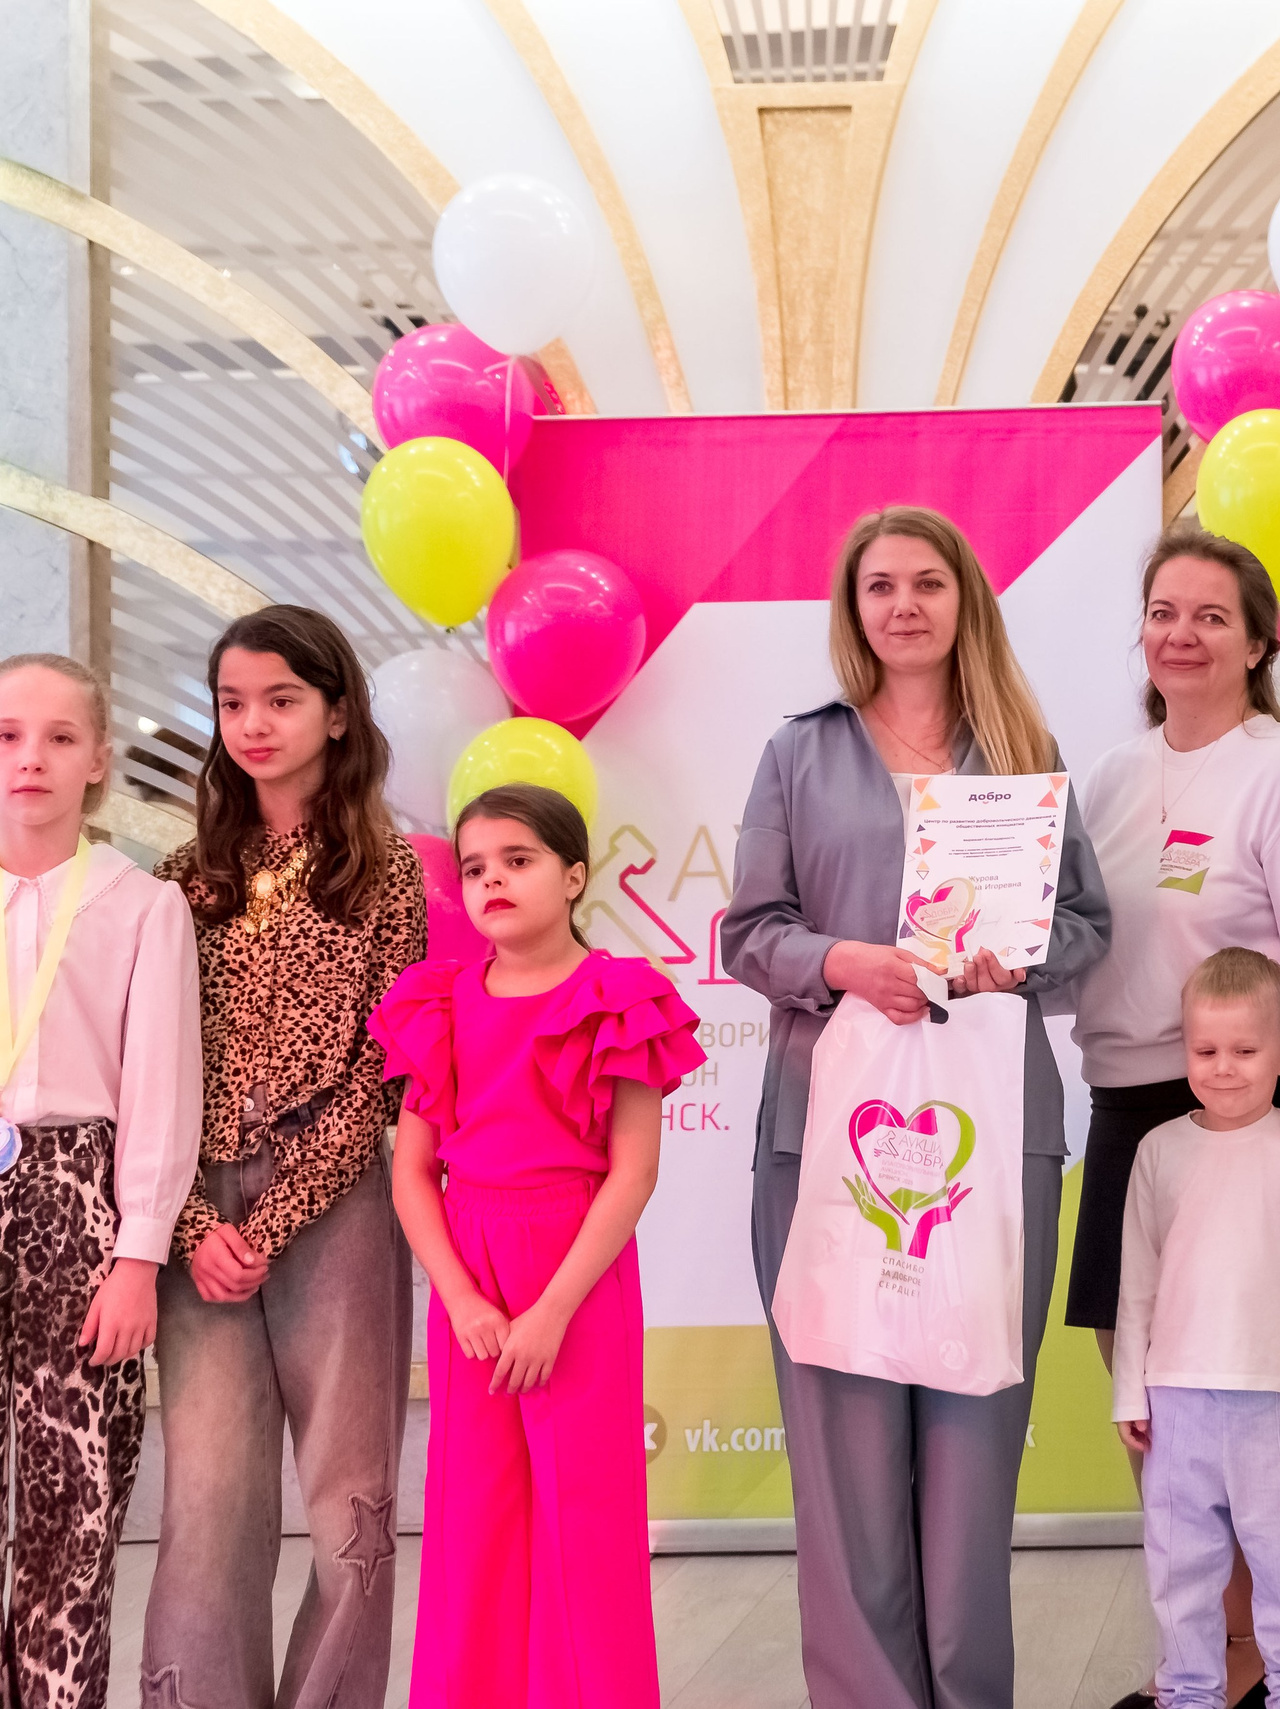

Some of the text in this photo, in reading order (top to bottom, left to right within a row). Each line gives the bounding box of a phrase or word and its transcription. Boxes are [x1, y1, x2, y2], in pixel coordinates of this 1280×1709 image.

[968, 791, 1012, 803] добро
[968, 874, 999, 883] Журова
[984, 881, 1022, 891] Игоревна
[699, 1022, 770, 1049] ВОРИ
[661, 1103, 730, 1131] НСК.
[882, 1256, 925, 1274] СПАСИБО
[880, 1268, 891, 1277] ЗА
